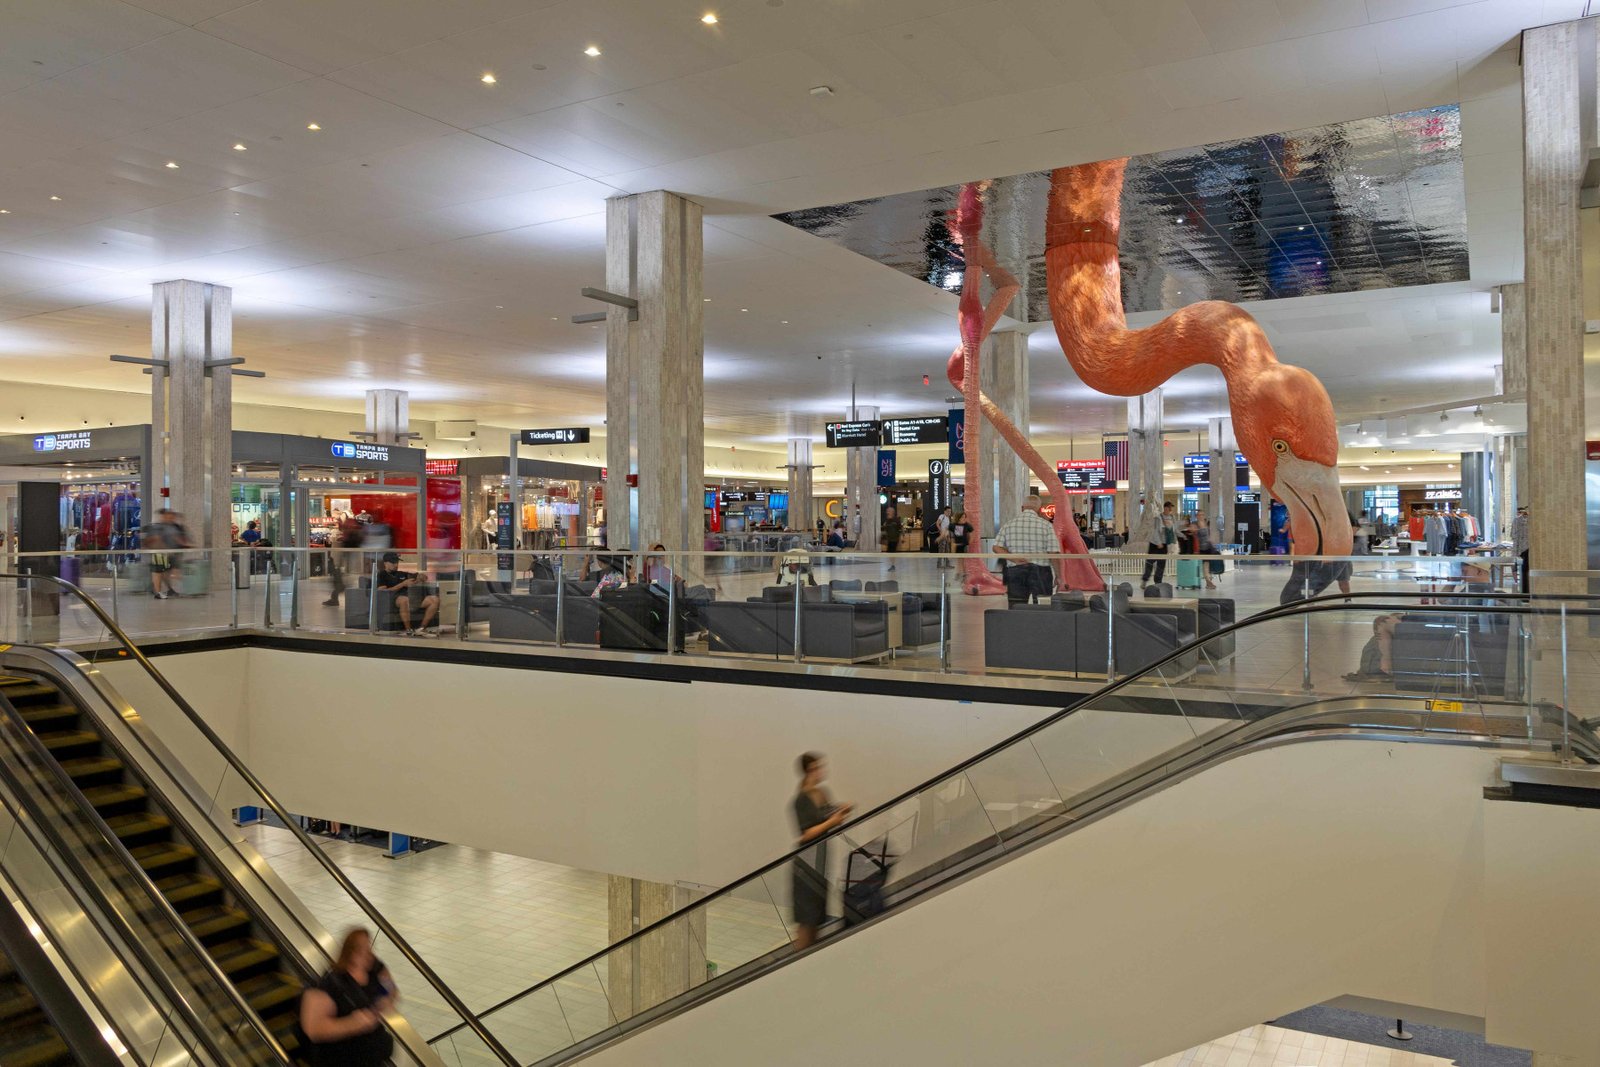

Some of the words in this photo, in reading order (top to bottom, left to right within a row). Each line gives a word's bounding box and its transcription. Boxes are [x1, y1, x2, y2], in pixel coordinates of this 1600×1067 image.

[530, 432, 556, 440] Ticketing
[34, 437, 55, 450] TB
[56, 439, 90, 450] SPORTS
[333, 444, 355, 456] TB
[356, 450, 388, 461] SPORTS
